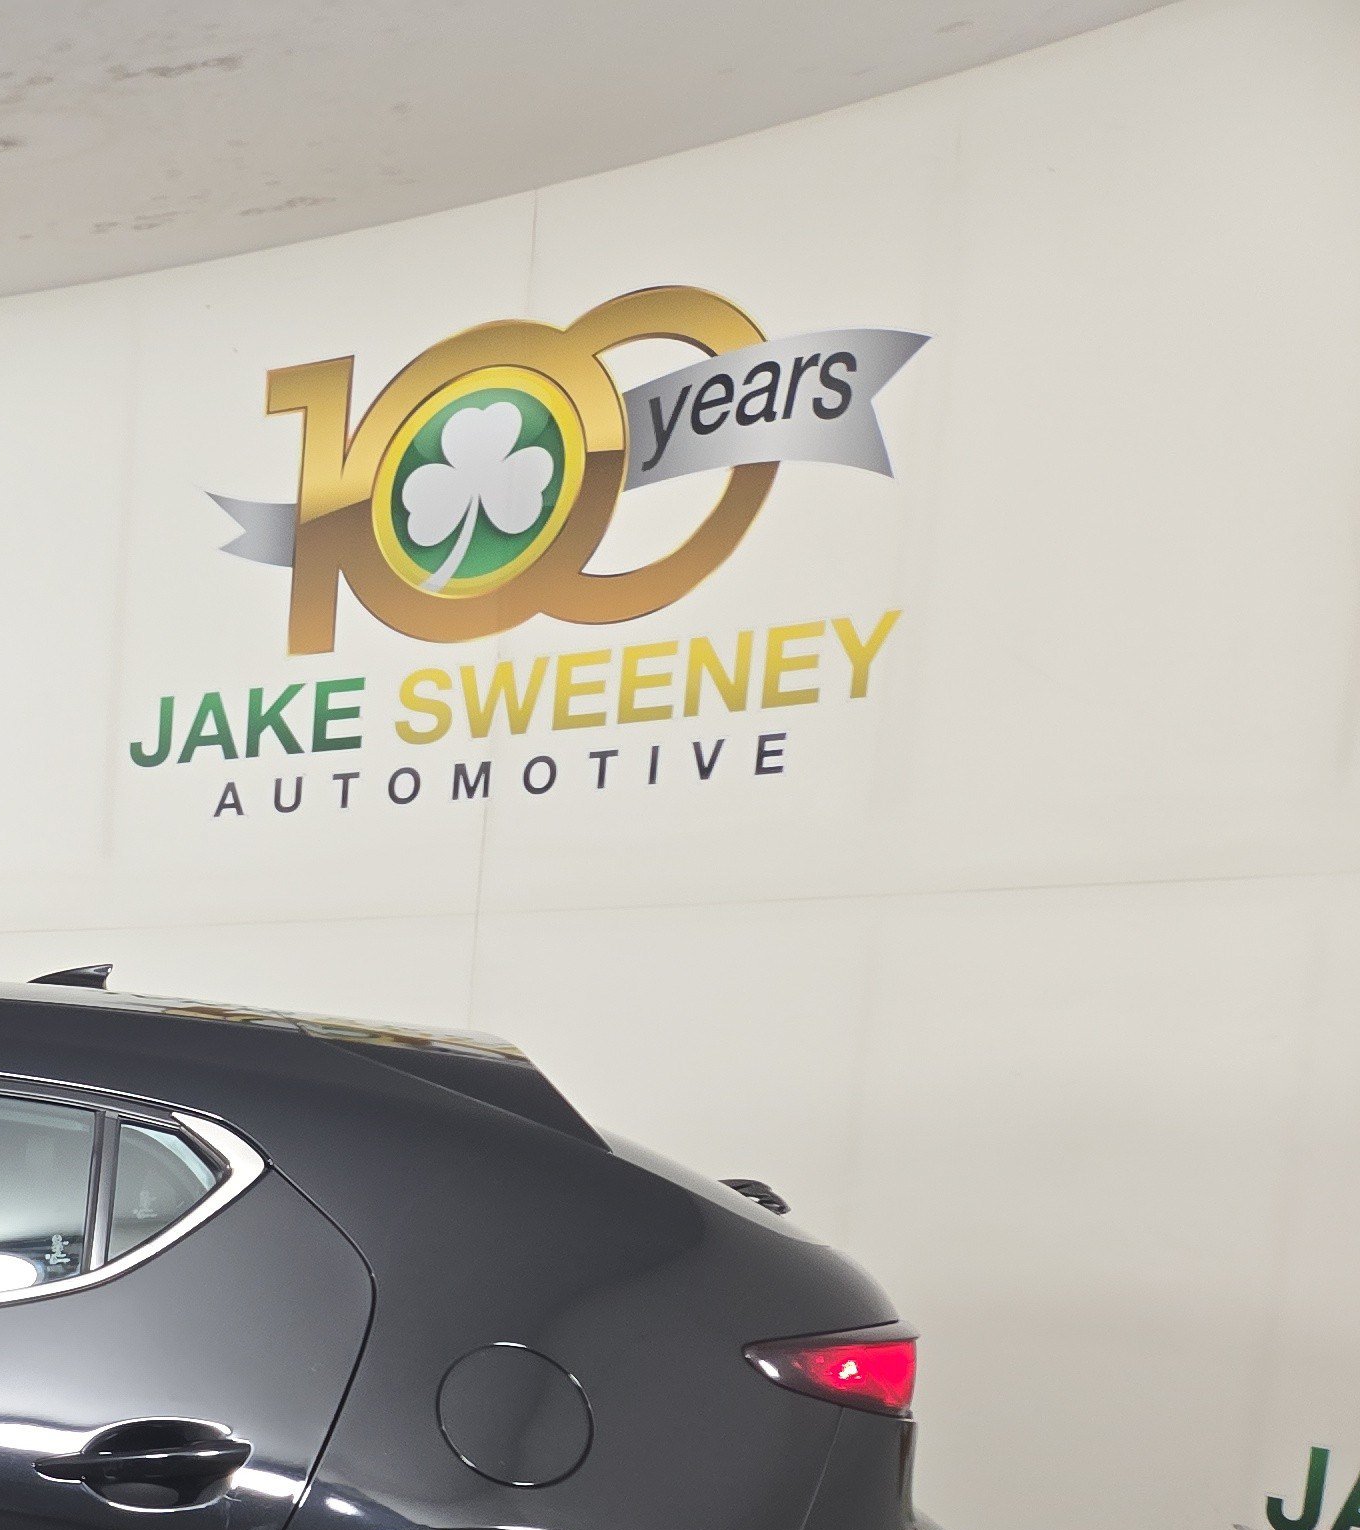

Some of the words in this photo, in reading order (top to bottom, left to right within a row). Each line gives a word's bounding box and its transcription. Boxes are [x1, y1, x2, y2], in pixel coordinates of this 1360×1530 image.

[641, 349, 858, 472] years
[128, 675, 367, 768] JAKE
[393, 609, 903, 746] SWEENEY
[213, 731, 788, 818] AUTOMOTIVE
